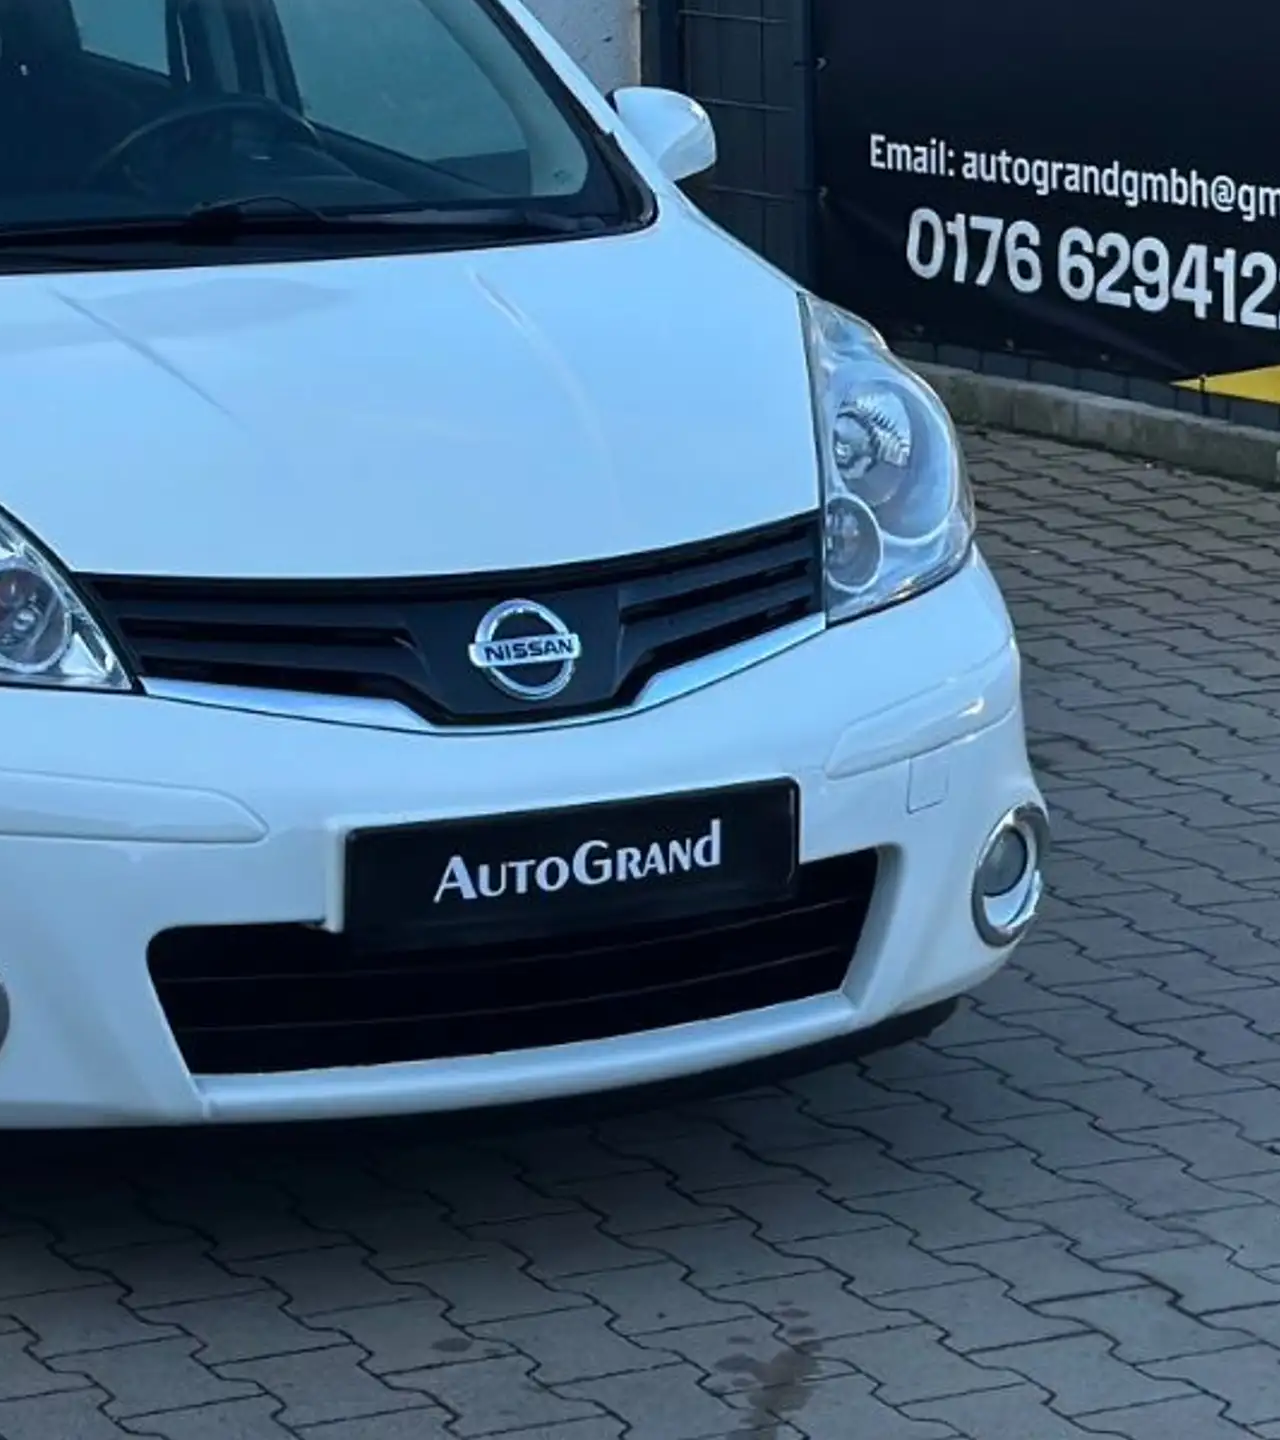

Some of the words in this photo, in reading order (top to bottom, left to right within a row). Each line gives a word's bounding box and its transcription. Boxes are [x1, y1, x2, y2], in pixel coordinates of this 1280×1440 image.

[870, 133, 955, 178] Email:
[906, 207, 1043, 293] 0176
[484, 639, 574, 661] NISSAN
